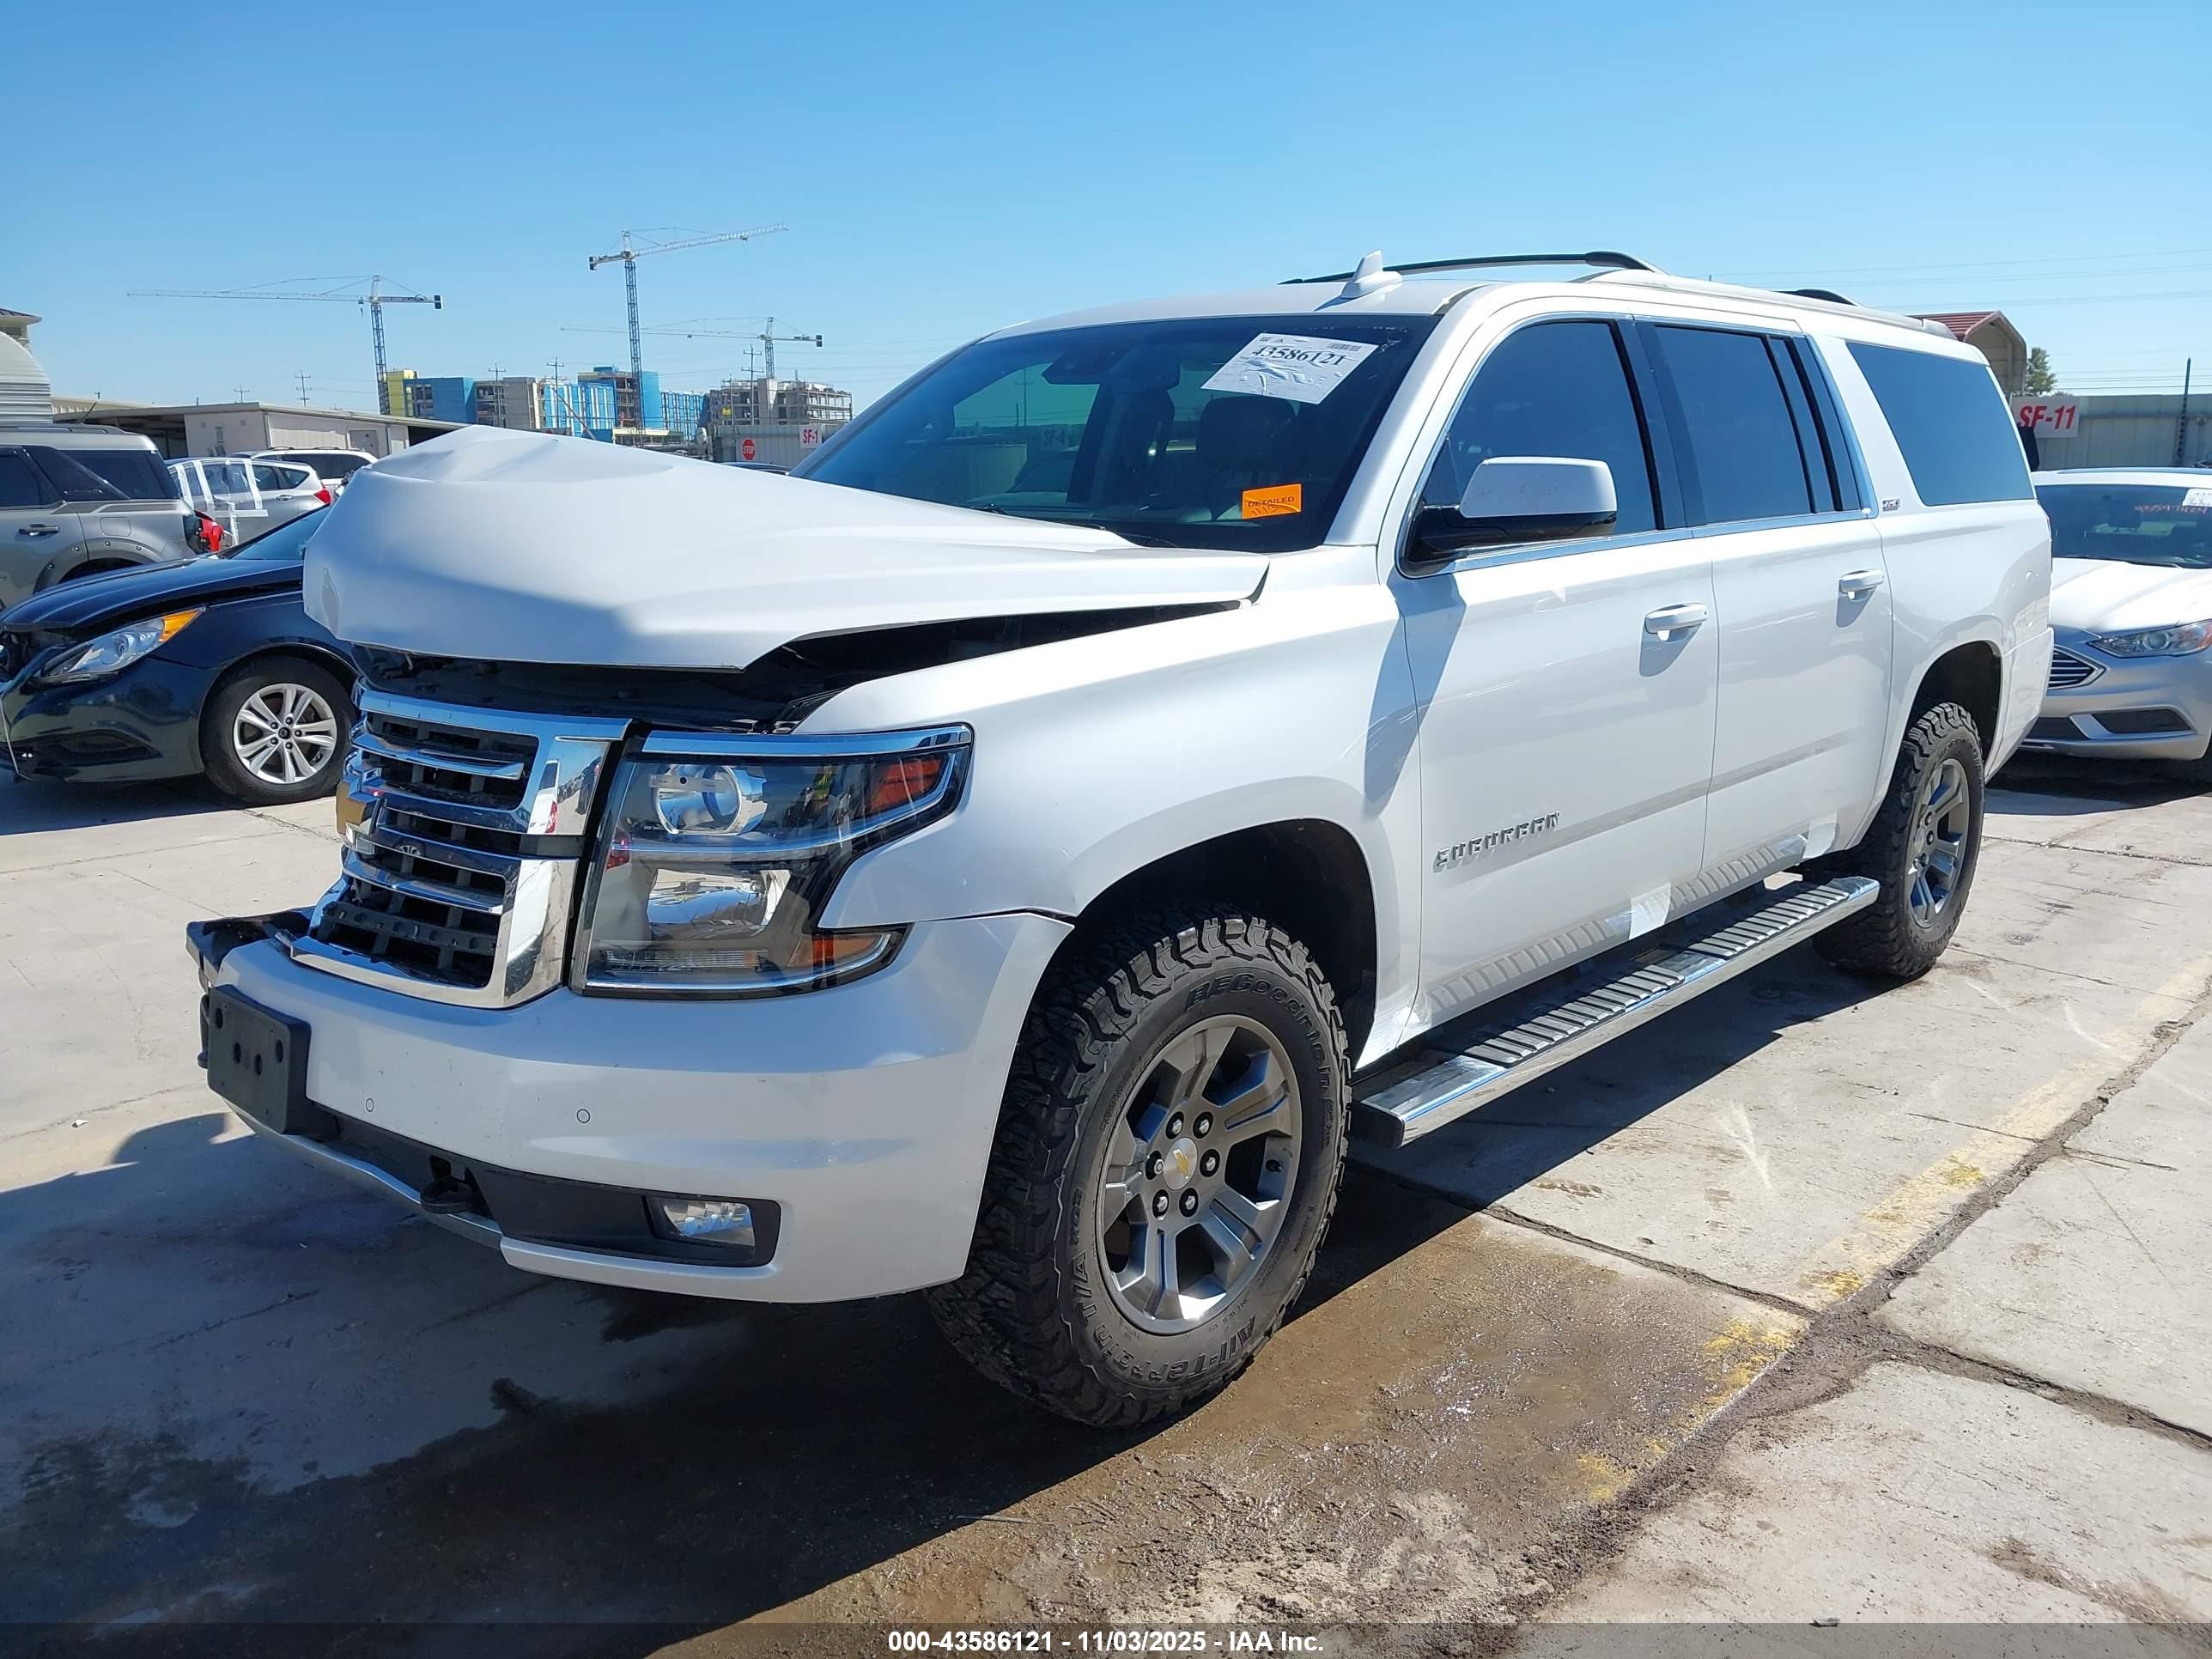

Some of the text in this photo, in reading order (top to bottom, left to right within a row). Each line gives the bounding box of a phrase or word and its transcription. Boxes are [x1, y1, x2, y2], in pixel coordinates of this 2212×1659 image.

[1251, 345, 1346, 366] 43586121
[2018, 404, 2076, 429] SF-11
[803, 428, 818, 444] SF-1
[743, 445, 756, 454] STOP
[1248, 495, 1295, 507] DETAILED
